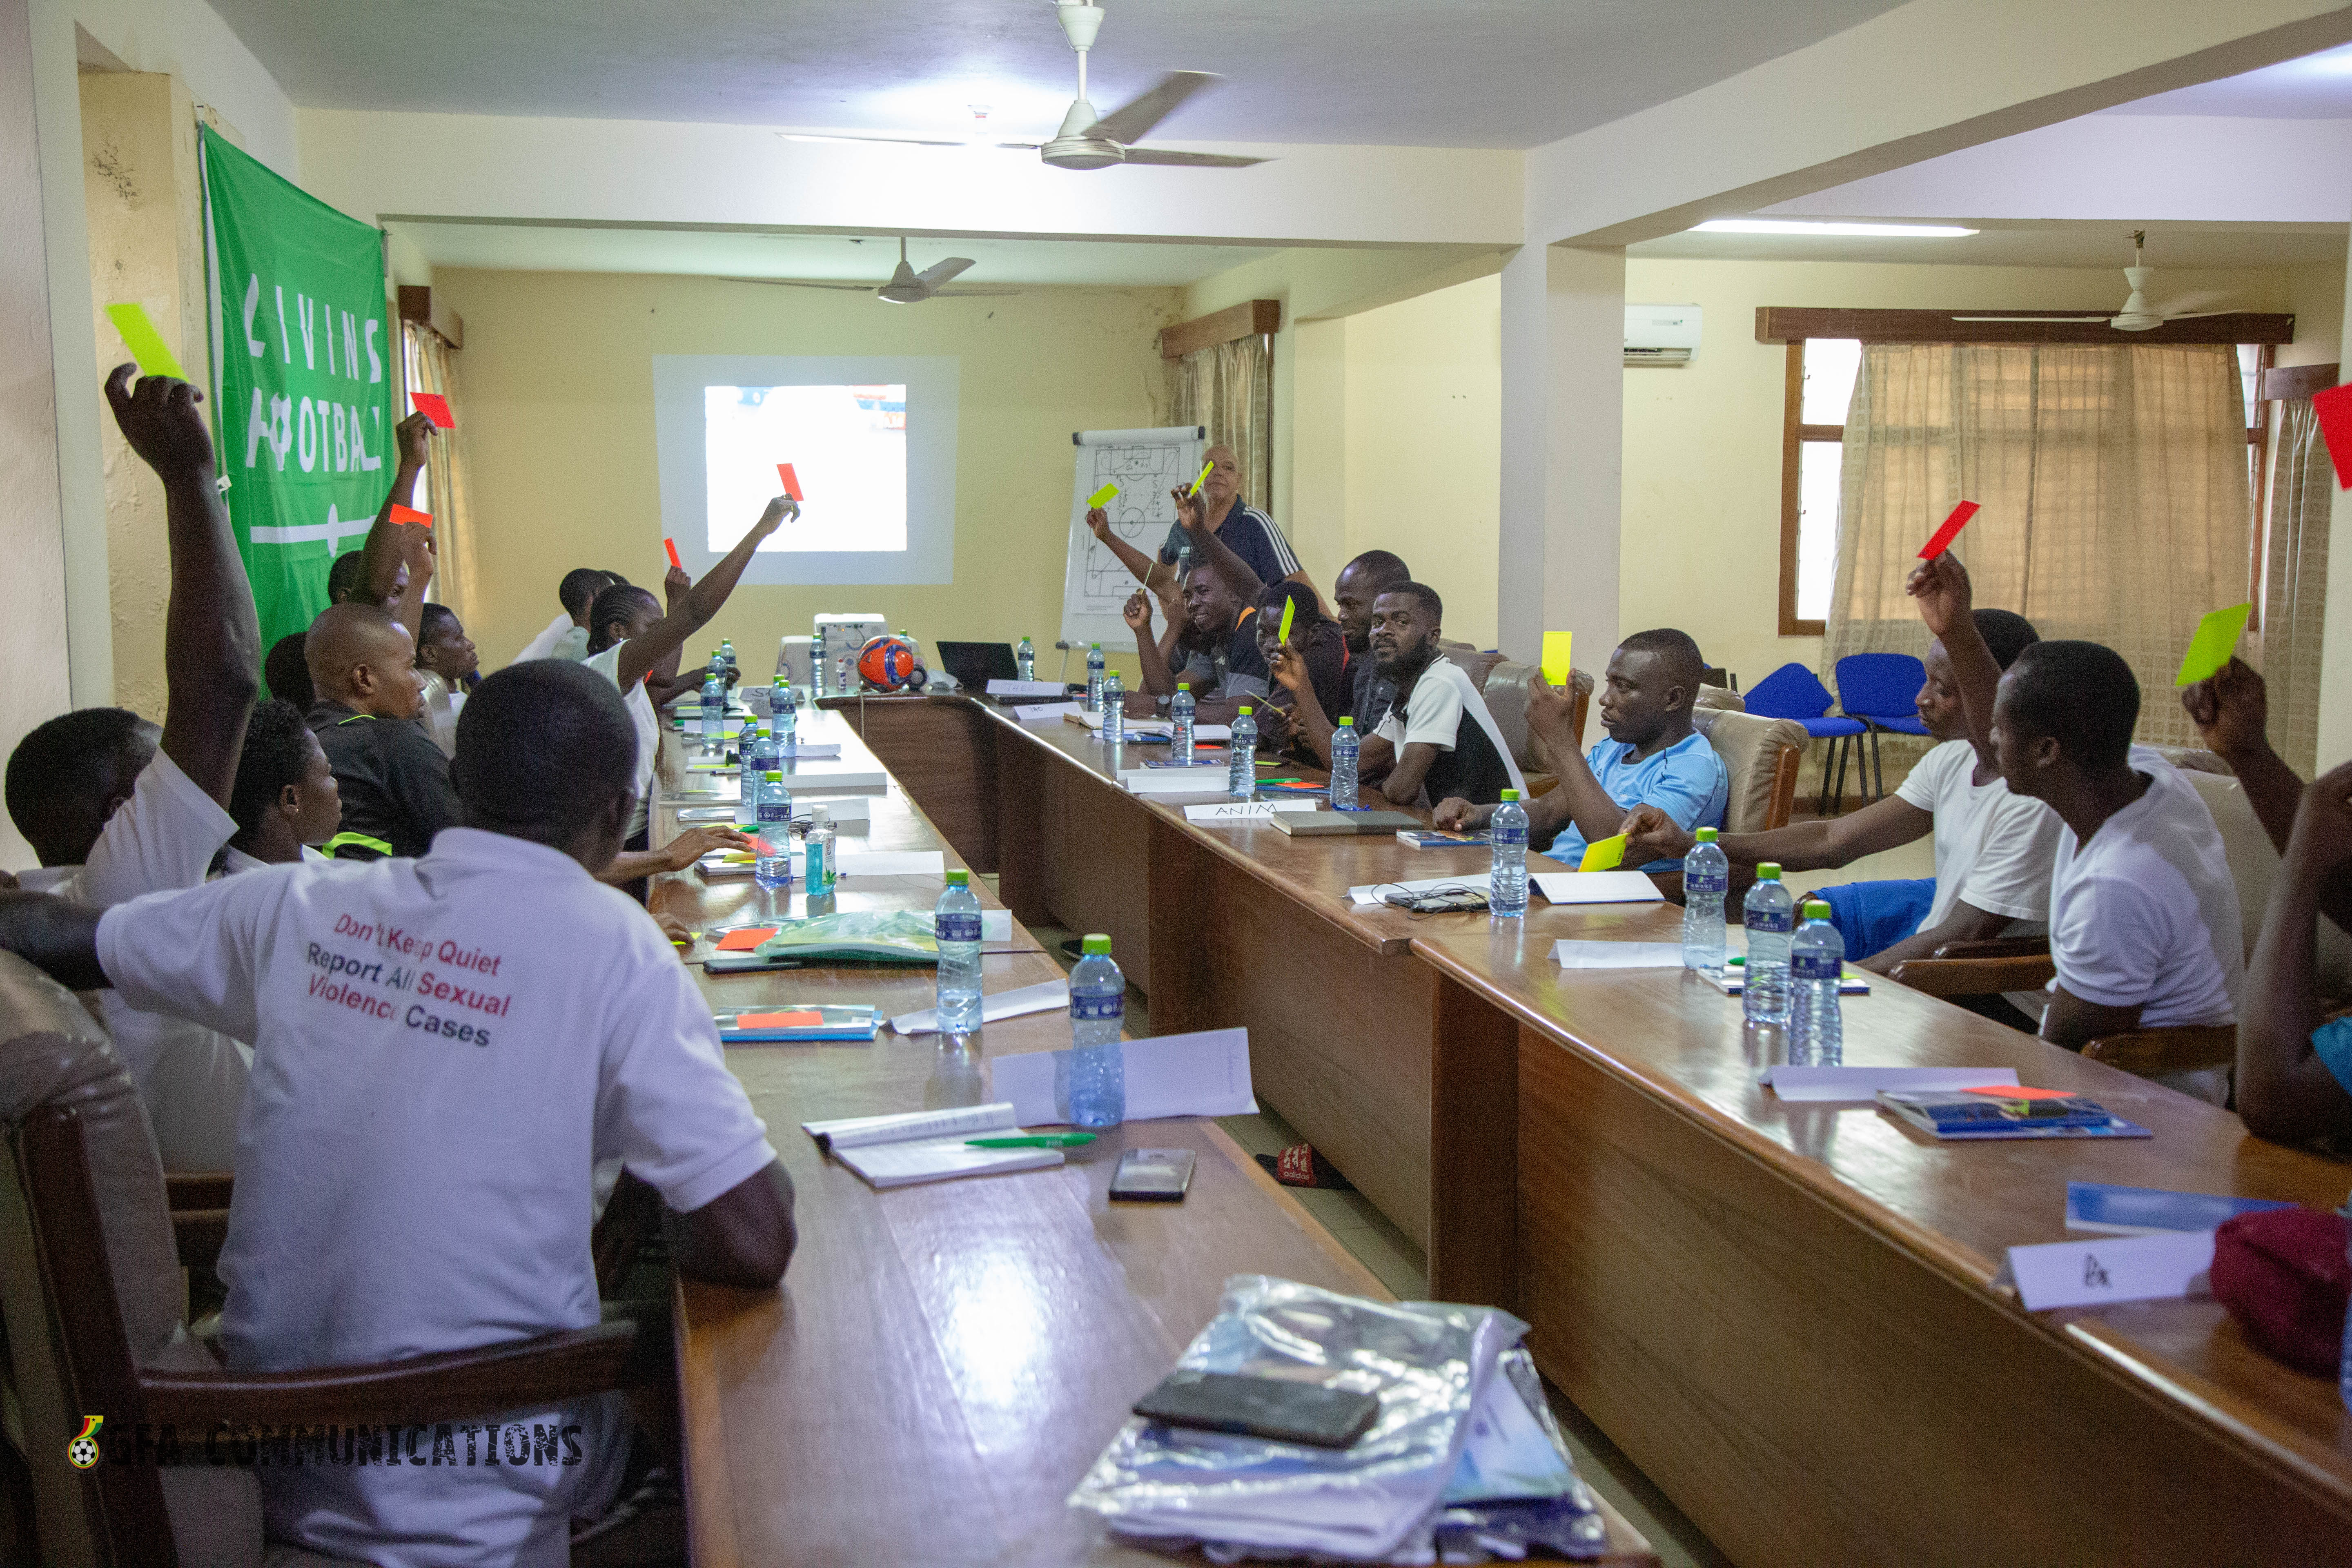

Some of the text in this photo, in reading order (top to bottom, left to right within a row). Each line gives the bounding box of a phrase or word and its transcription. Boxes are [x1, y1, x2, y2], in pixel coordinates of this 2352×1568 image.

[1215, 803, 1277, 815] ANIM
[334, 913, 384, 947] Don't
[438, 940, 501, 976] Quiet
[307, 942, 511, 1017] Report All Sexual
[405, 1004, 490, 1047] Cases
[1283, 1172, 1309, 1180] adidas
